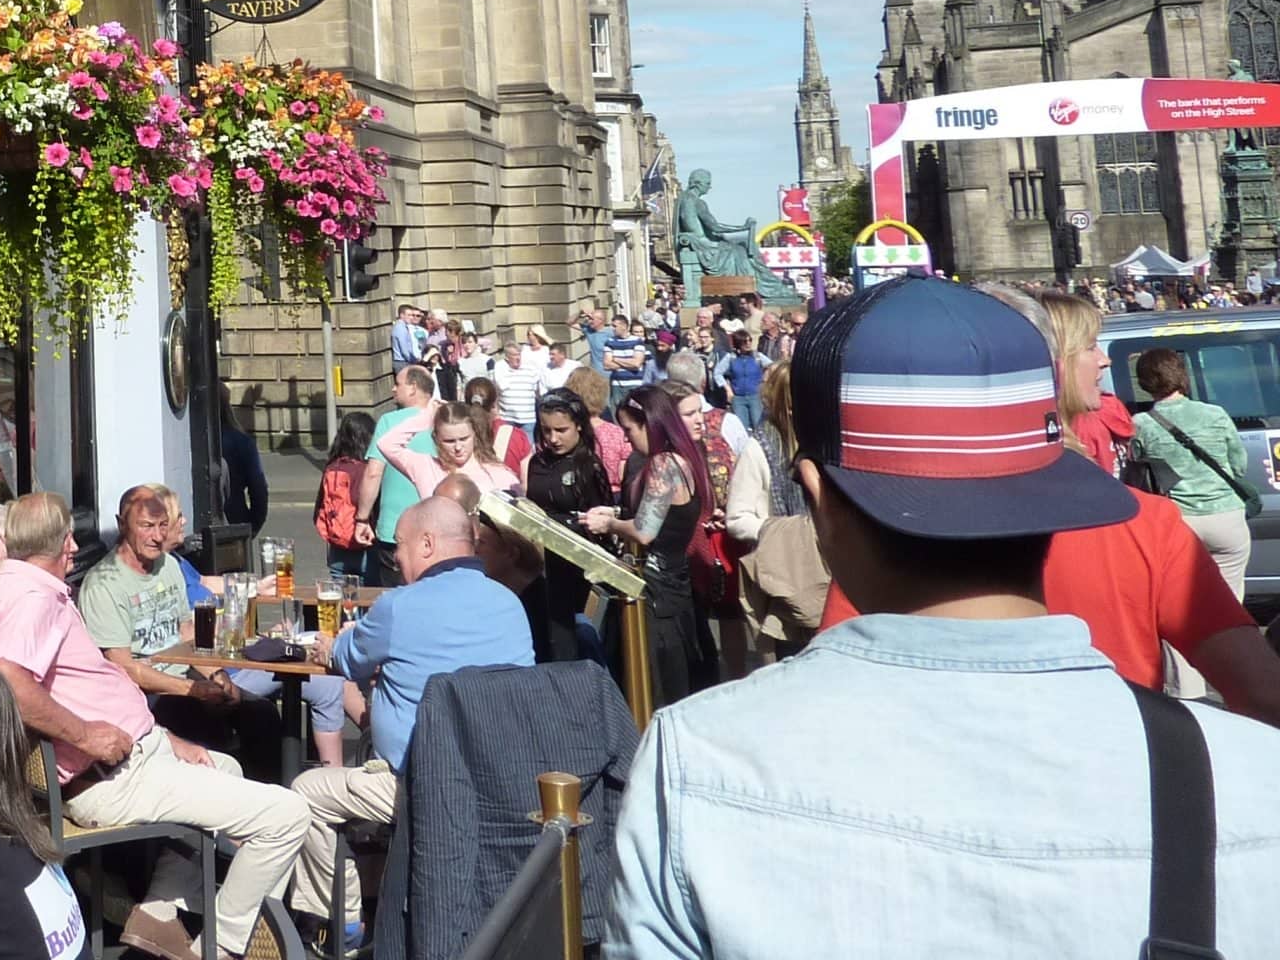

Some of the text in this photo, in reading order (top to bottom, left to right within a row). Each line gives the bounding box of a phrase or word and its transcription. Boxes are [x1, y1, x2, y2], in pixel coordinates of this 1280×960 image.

[1157, 96, 1266, 109] The bank that performs
[1082, 103, 1125, 117] money
[1170, 109, 1184, 119] on
[1185, 108, 1201, 118] the
[1202, 107, 1225, 119] High
[935, 106, 999, 131] fringe
[1073, 216, 1087, 226] 20
